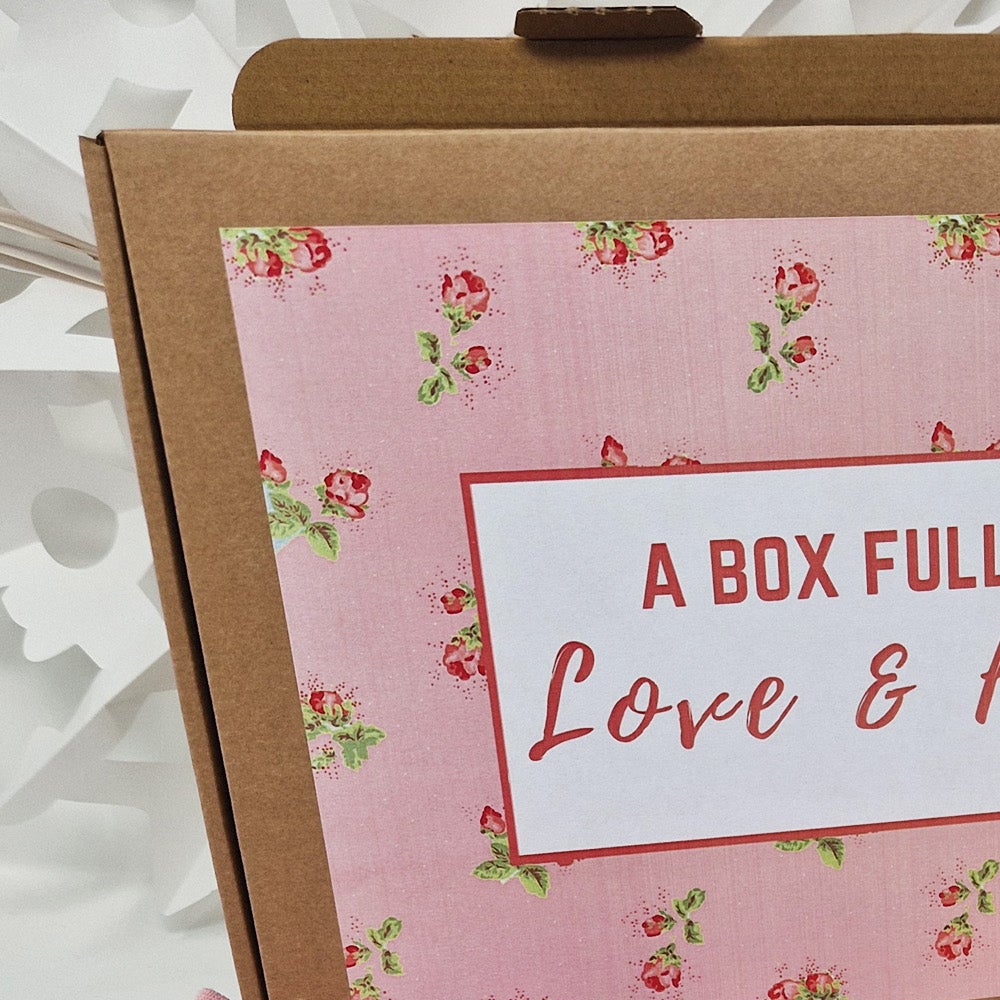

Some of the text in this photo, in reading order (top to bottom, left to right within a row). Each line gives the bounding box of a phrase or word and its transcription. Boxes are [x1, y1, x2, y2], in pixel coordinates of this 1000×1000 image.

[641, 541, 686, 609] A
[710, 533, 839, 605] BOX
[527, 640, 799, 762] Love
[855, 642, 917, 731] &
